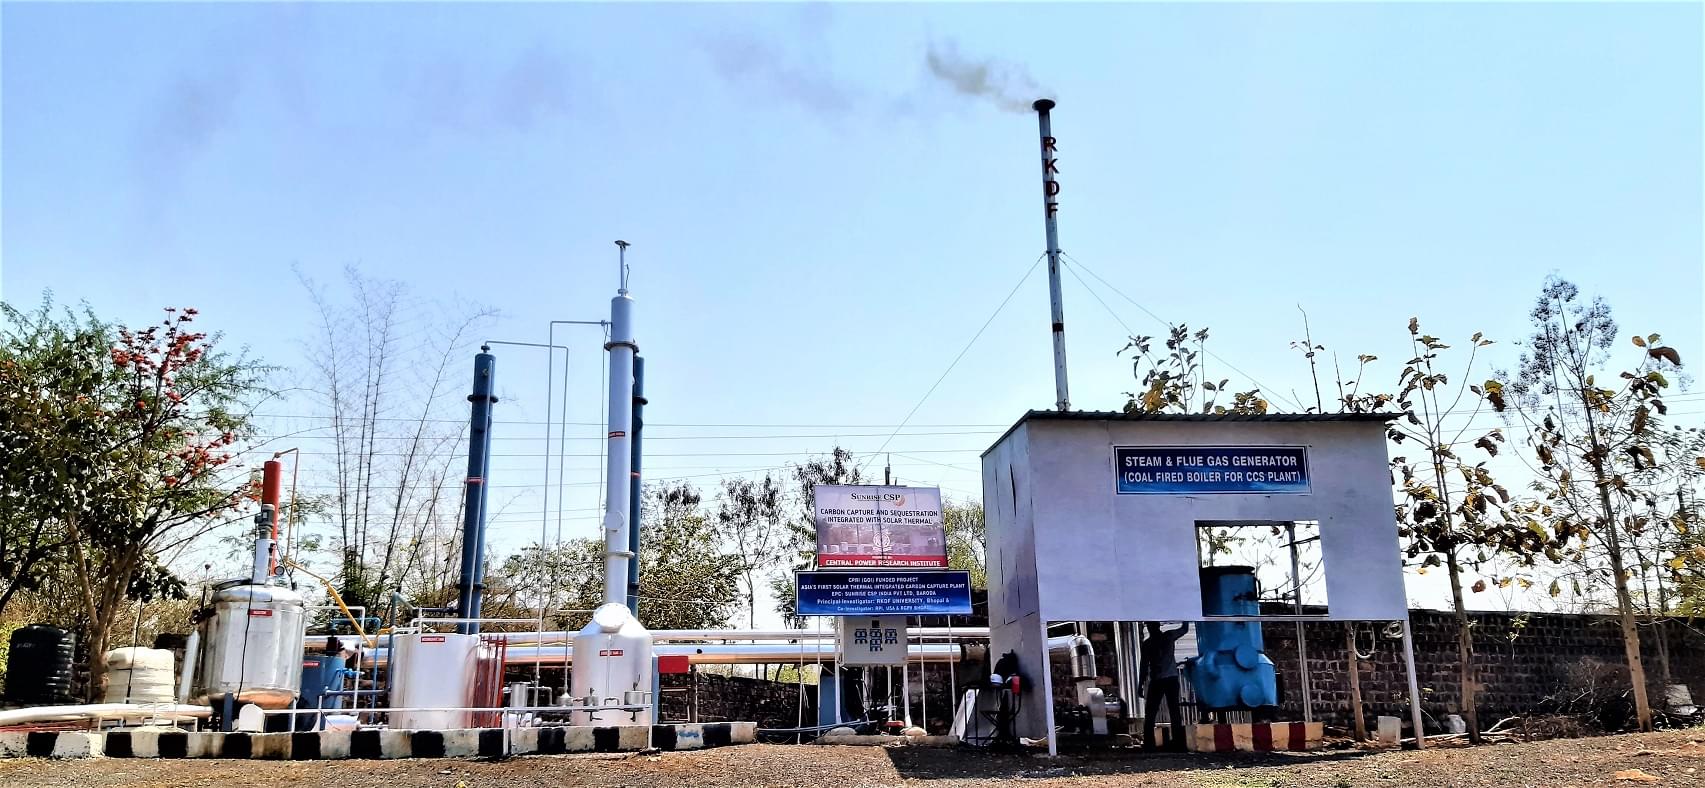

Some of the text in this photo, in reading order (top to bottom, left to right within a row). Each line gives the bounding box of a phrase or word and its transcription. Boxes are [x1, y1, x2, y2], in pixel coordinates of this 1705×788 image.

[1042, 136, 1060, 218] RKDF
[1125, 456, 1297, 466] STEAM & FLUE GAS GENERATOR
[1124, 471, 1300, 484] (COAL FIRED BOILER FOR CCS PLANT)
